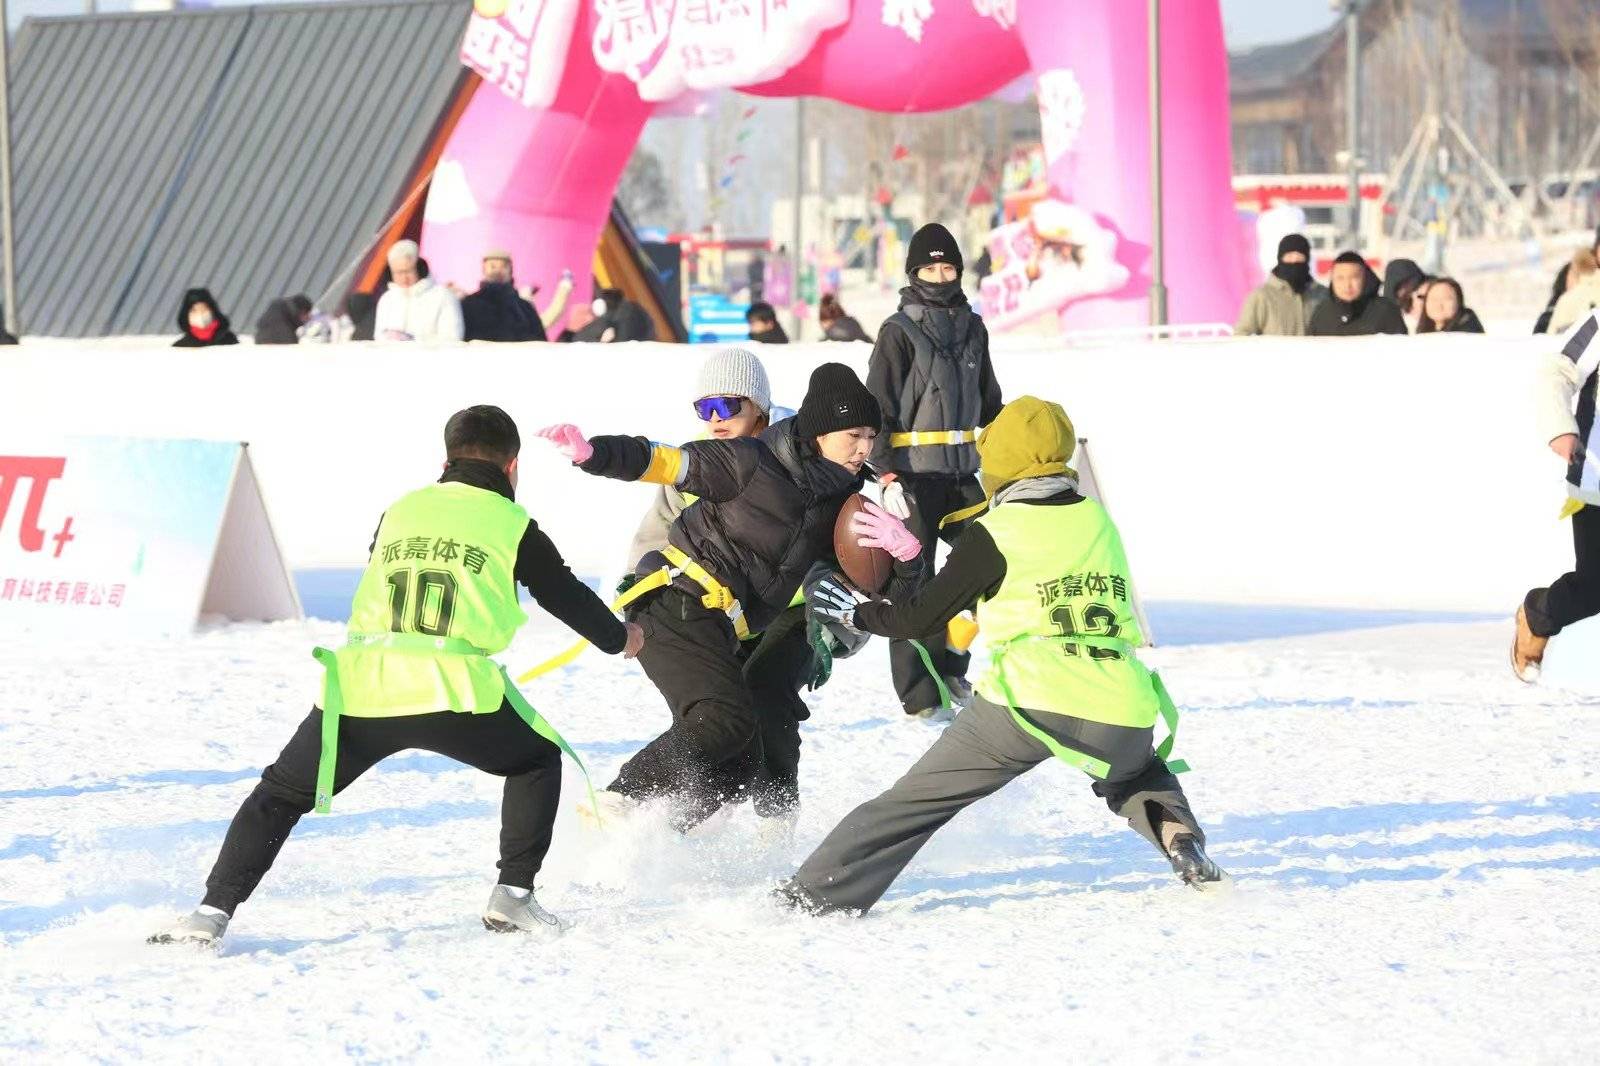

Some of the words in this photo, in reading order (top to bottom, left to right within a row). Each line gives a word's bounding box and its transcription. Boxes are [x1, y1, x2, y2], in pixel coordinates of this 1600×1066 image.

[382, 536, 489, 575] 派嘉体育
[386, 567, 458, 637] 10
[1036, 571, 1127, 607] 派嘉体育
